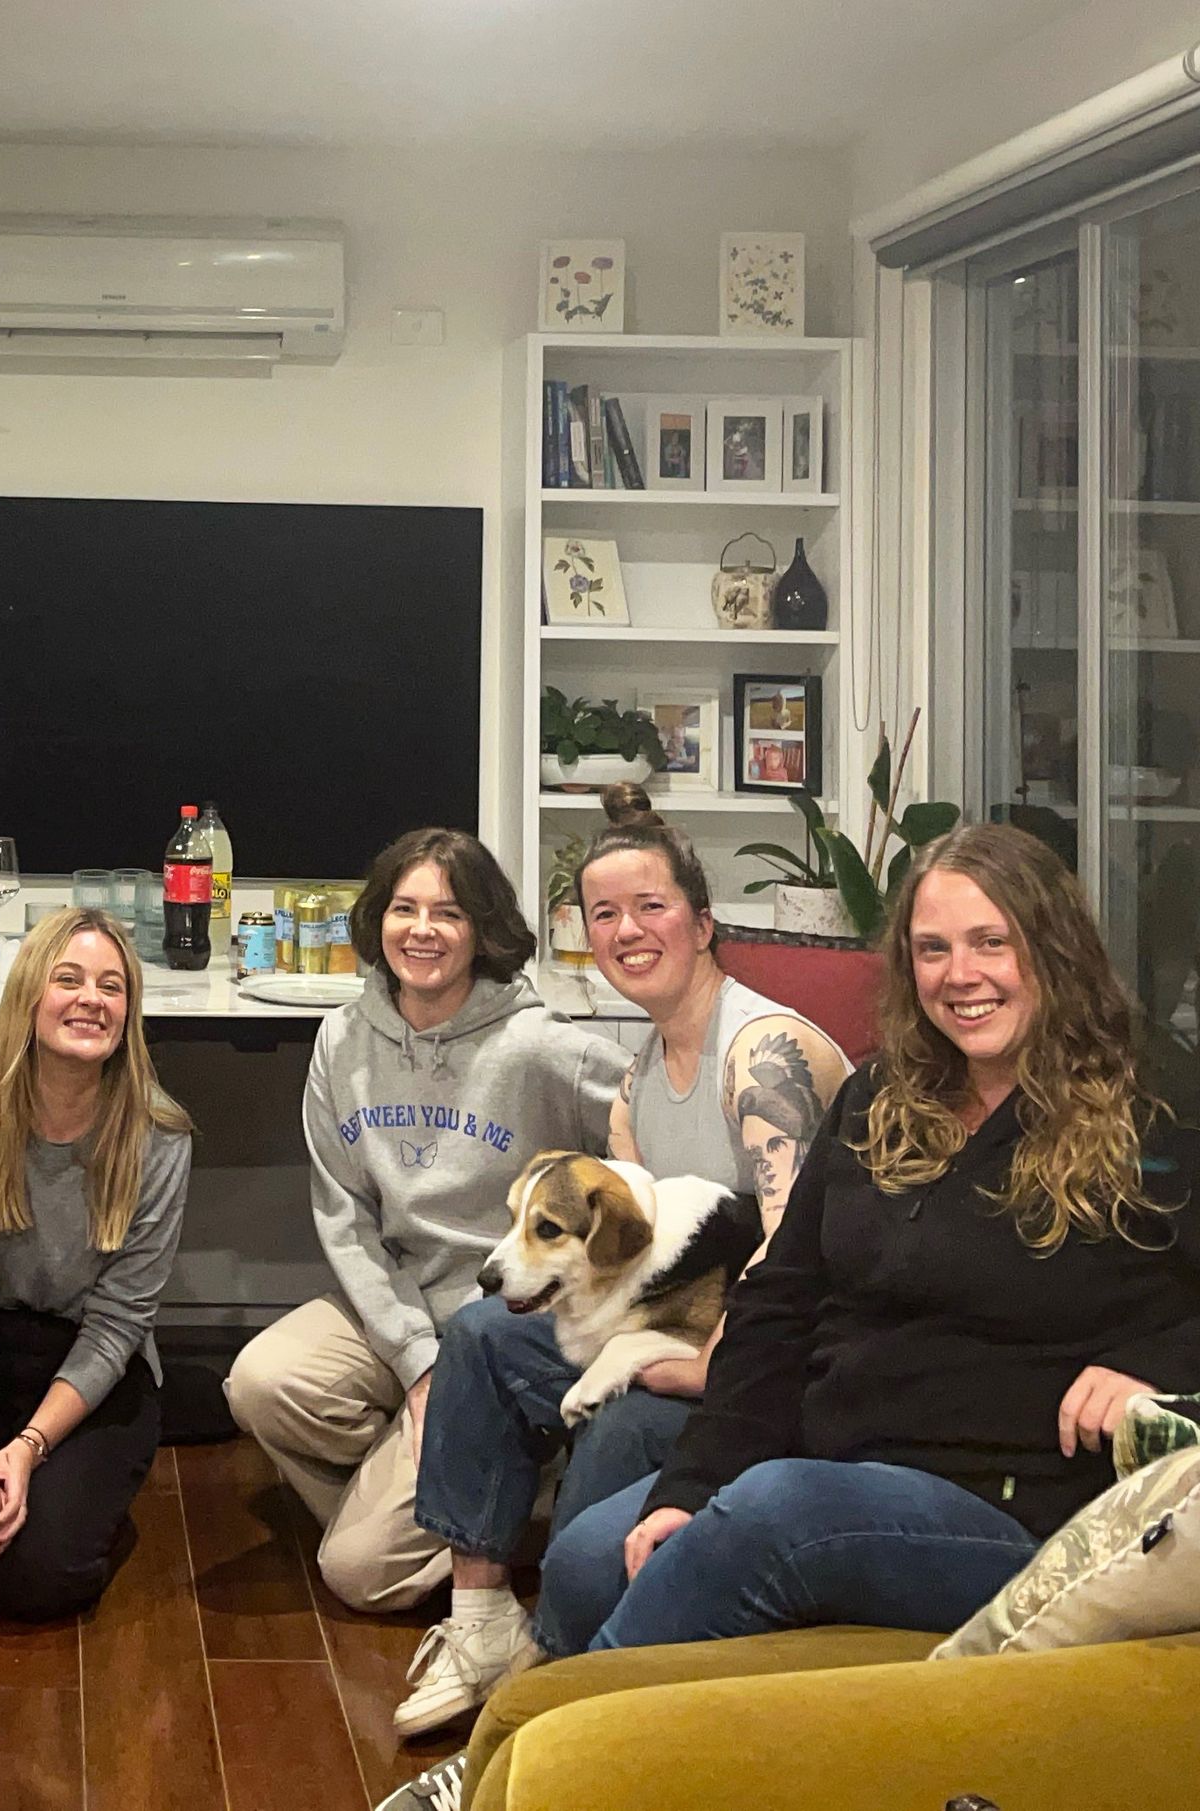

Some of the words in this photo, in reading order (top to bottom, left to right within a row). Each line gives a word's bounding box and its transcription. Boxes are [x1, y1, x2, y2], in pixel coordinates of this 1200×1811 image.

[340, 1104, 416, 1146] BETWEEN
[420, 1104, 460, 1131] YOU
[464, 1112, 477, 1138] &
[482, 1120, 514, 1153] ME
